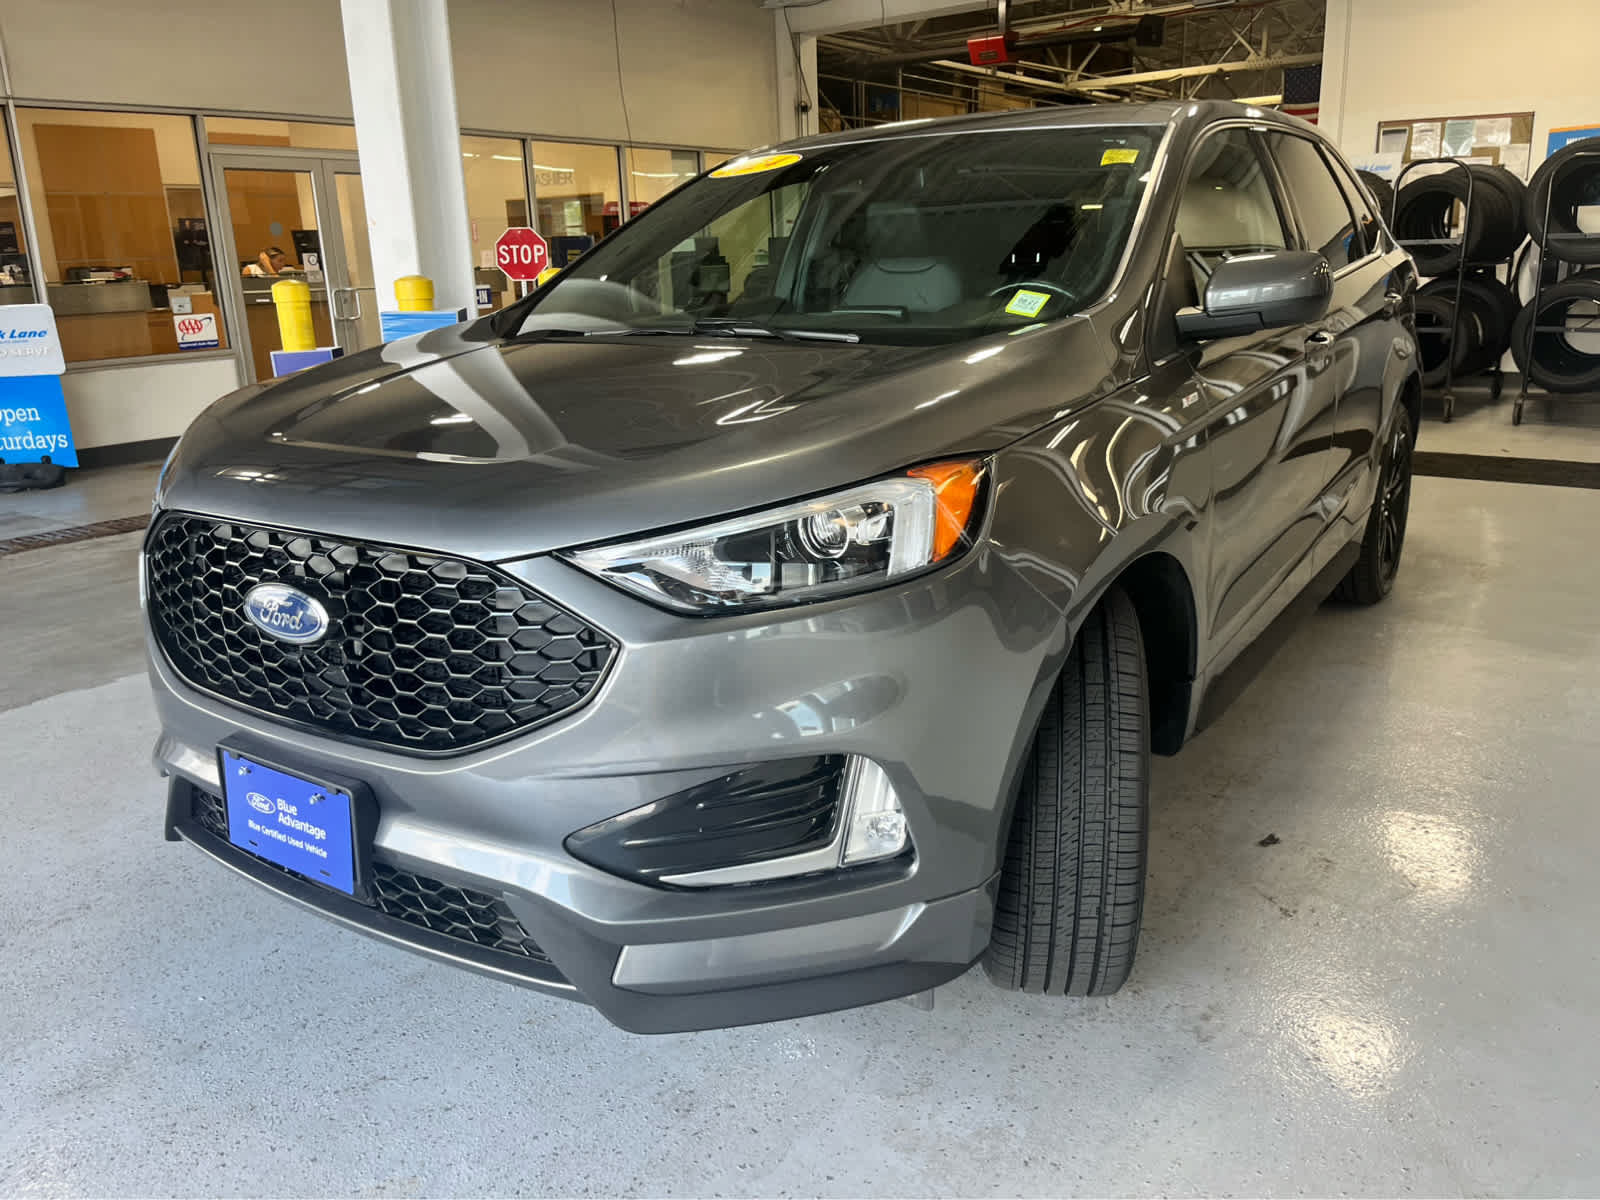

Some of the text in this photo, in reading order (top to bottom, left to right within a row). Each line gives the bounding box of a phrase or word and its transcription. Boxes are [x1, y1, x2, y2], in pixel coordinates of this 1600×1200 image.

[499, 244, 545, 265] STOP
[9, 329, 48, 339] Lane
[179, 319, 203, 334] AAA
[259, 599, 305, 630] Ford
[250, 794, 271, 811] Ford
[276, 798, 298, 816] Blue
[278, 812, 327, 840] Advantage
[247, 818, 328, 859] Blue Certified Used Vehicle
